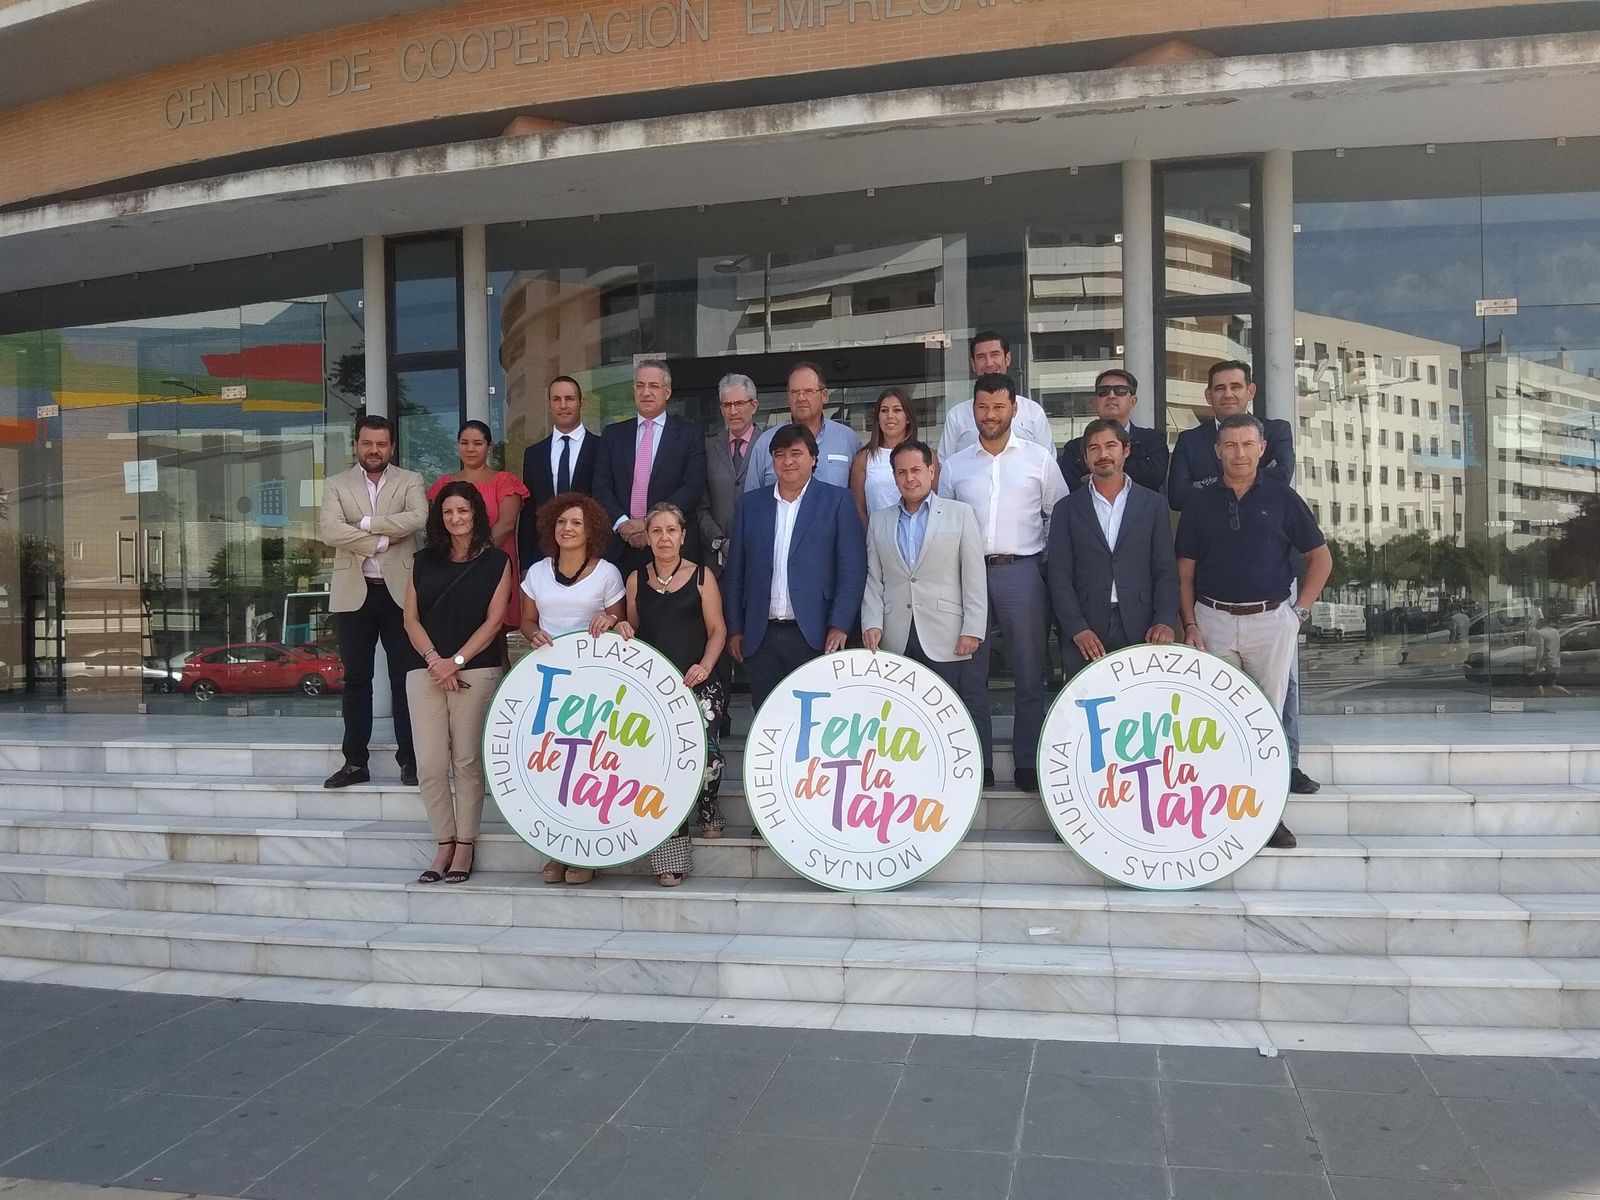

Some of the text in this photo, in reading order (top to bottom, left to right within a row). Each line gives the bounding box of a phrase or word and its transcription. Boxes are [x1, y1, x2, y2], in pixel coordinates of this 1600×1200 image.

[164, 64, 301, 130] CENTRO
[327, 49, 372, 97] DE
[400, 0, 710, 83] COOPERACION
[491, 697, 523, 797] HUELVA
[531, 663, 656, 748] Feria
[576, 637, 697, 772] PLAZA DE LAS
[792, 689, 928, 763] Feria
[832, 657, 974, 781] PLAZA DE LAS
[1074, 692, 1226, 774] Feria
[1110, 652, 1281, 762] PLAZA DE LAS
[526, 730, 622, 773] de la
[554, 737, 669, 825] Tapa
[754, 728, 787, 830] HUELVA
[794, 748, 896, 800] de la
[1049, 741, 1096, 845] HUELVA
[1097, 744, 1200, 809] de la
[528, 819, 639, 858] MONJAS
[820, 759, 950, 844] Tapa
[1119, 757, 1265, 840] Tapa
[804, 845, 923, 881] MONJAS
[1122, 834, 1245, 882] MONJAS
